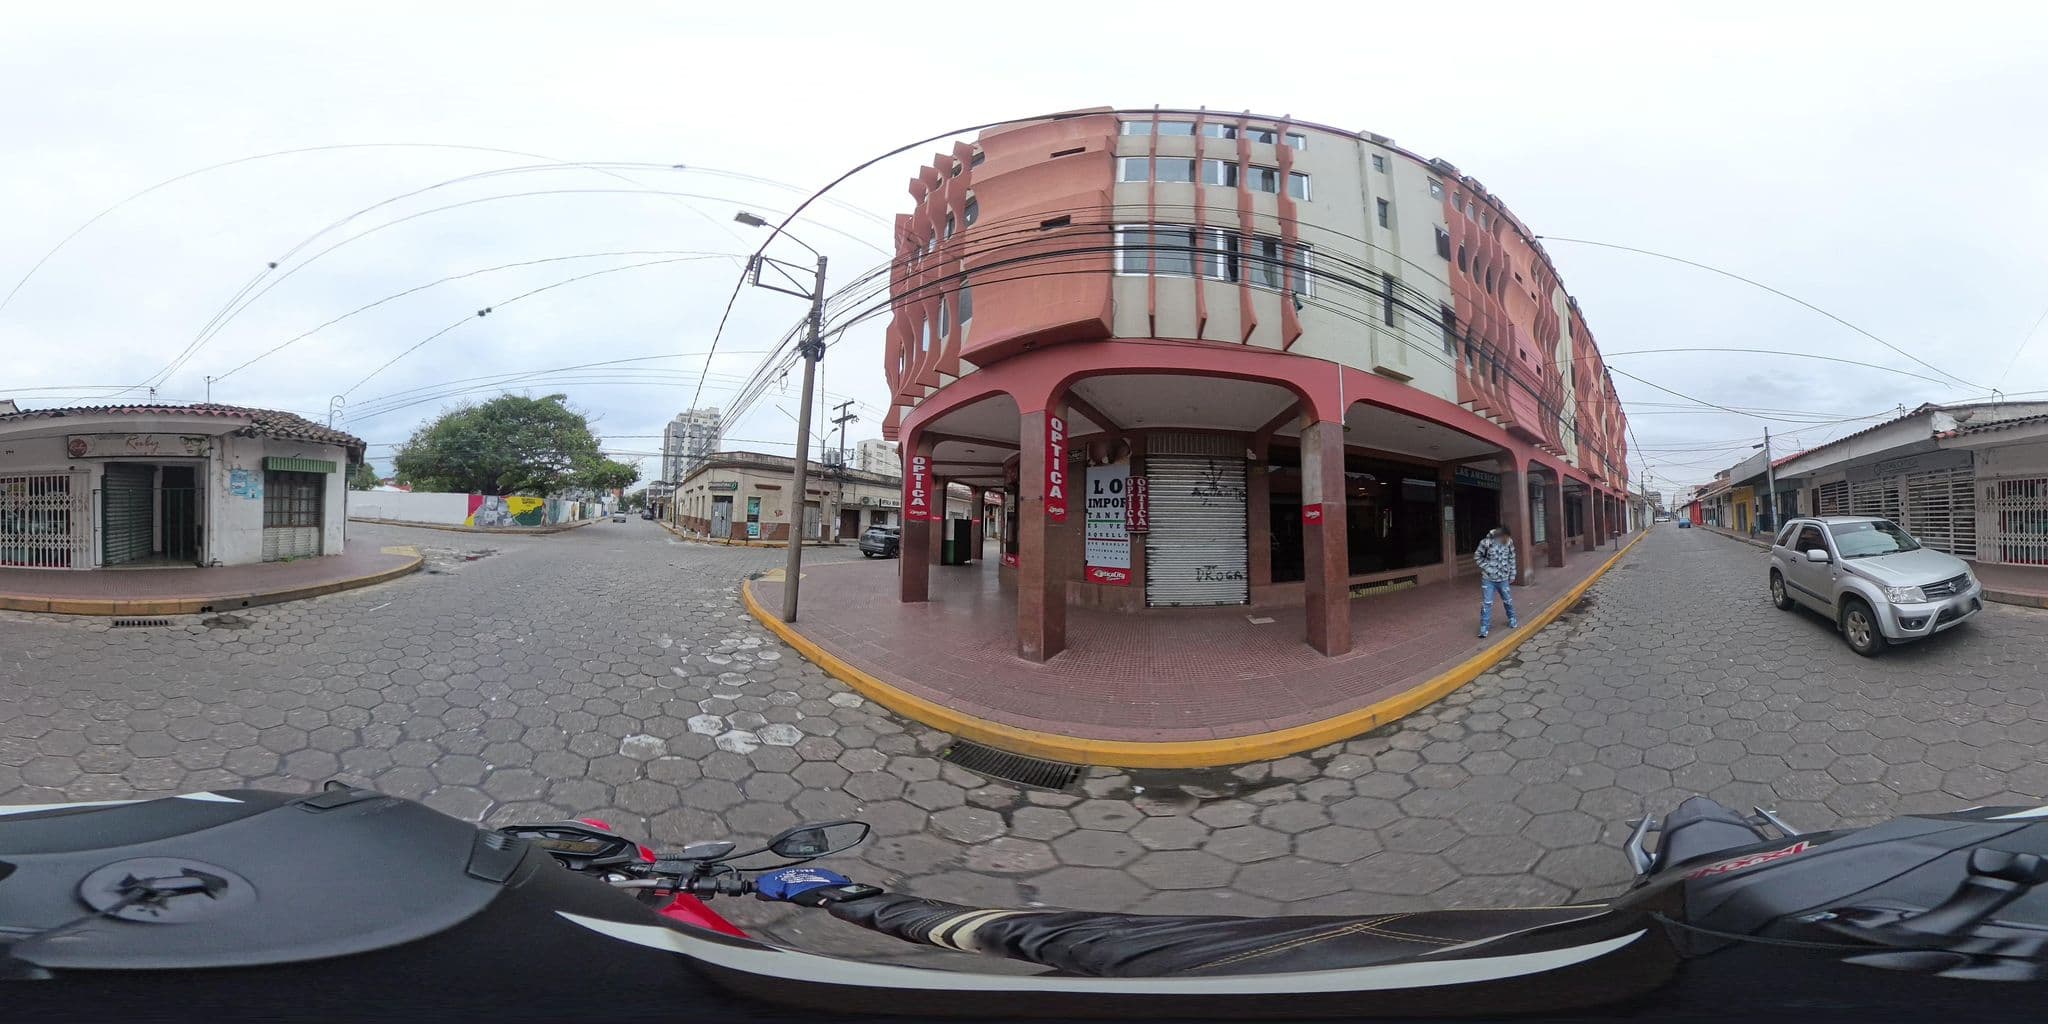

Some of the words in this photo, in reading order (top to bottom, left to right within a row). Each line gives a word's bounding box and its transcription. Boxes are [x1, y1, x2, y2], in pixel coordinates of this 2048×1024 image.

[911, 456, 926, 506] OPTICA
[1049, 416, 1063, 499] OPTICA
[1087, 511, 1120, 519] TANT
[1126, 478, 1135, 526] OPTICA
[1136, 478, 1147, 526] OPTICA
